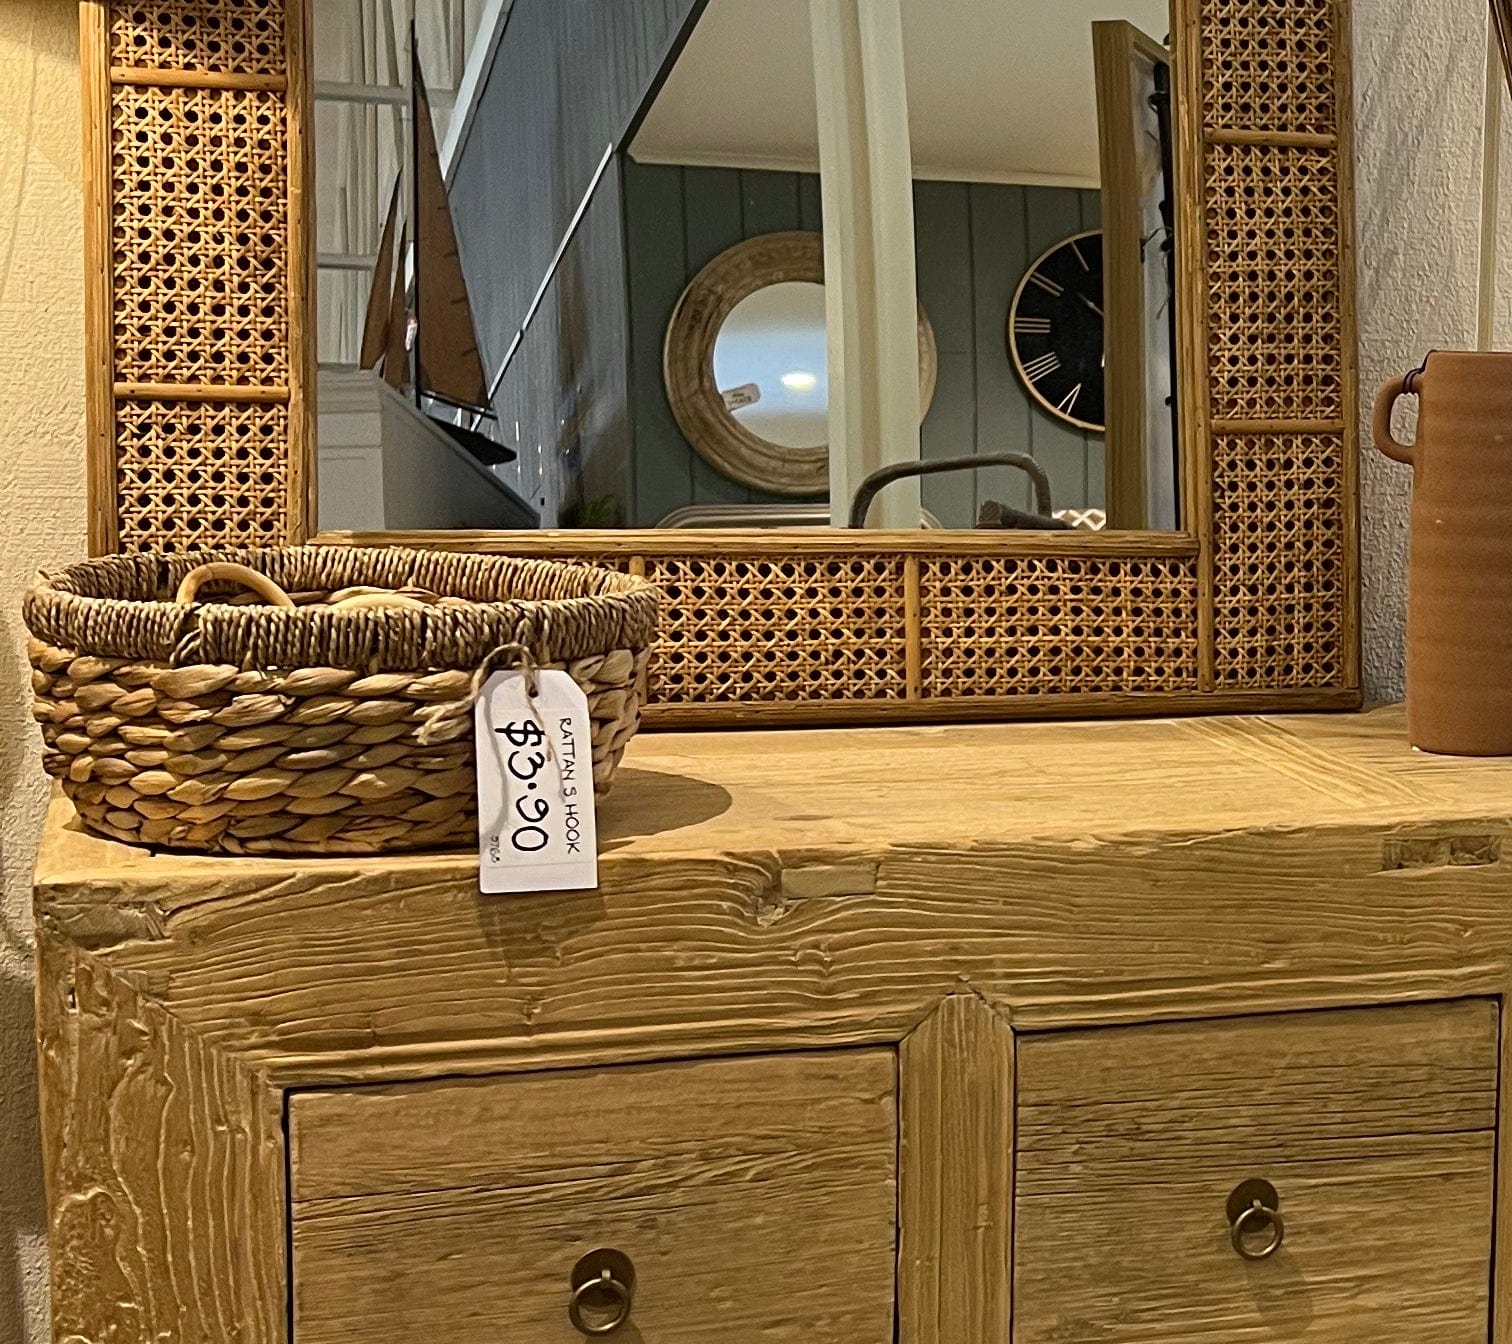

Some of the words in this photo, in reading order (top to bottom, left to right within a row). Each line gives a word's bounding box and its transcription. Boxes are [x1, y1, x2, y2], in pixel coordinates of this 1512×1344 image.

[560, 718, 575, 780] RATTAN
[495, 720, 549, 851] $3.90
[564, 787, 577, 797] S
[565, 804, 580, 854] HOOK
